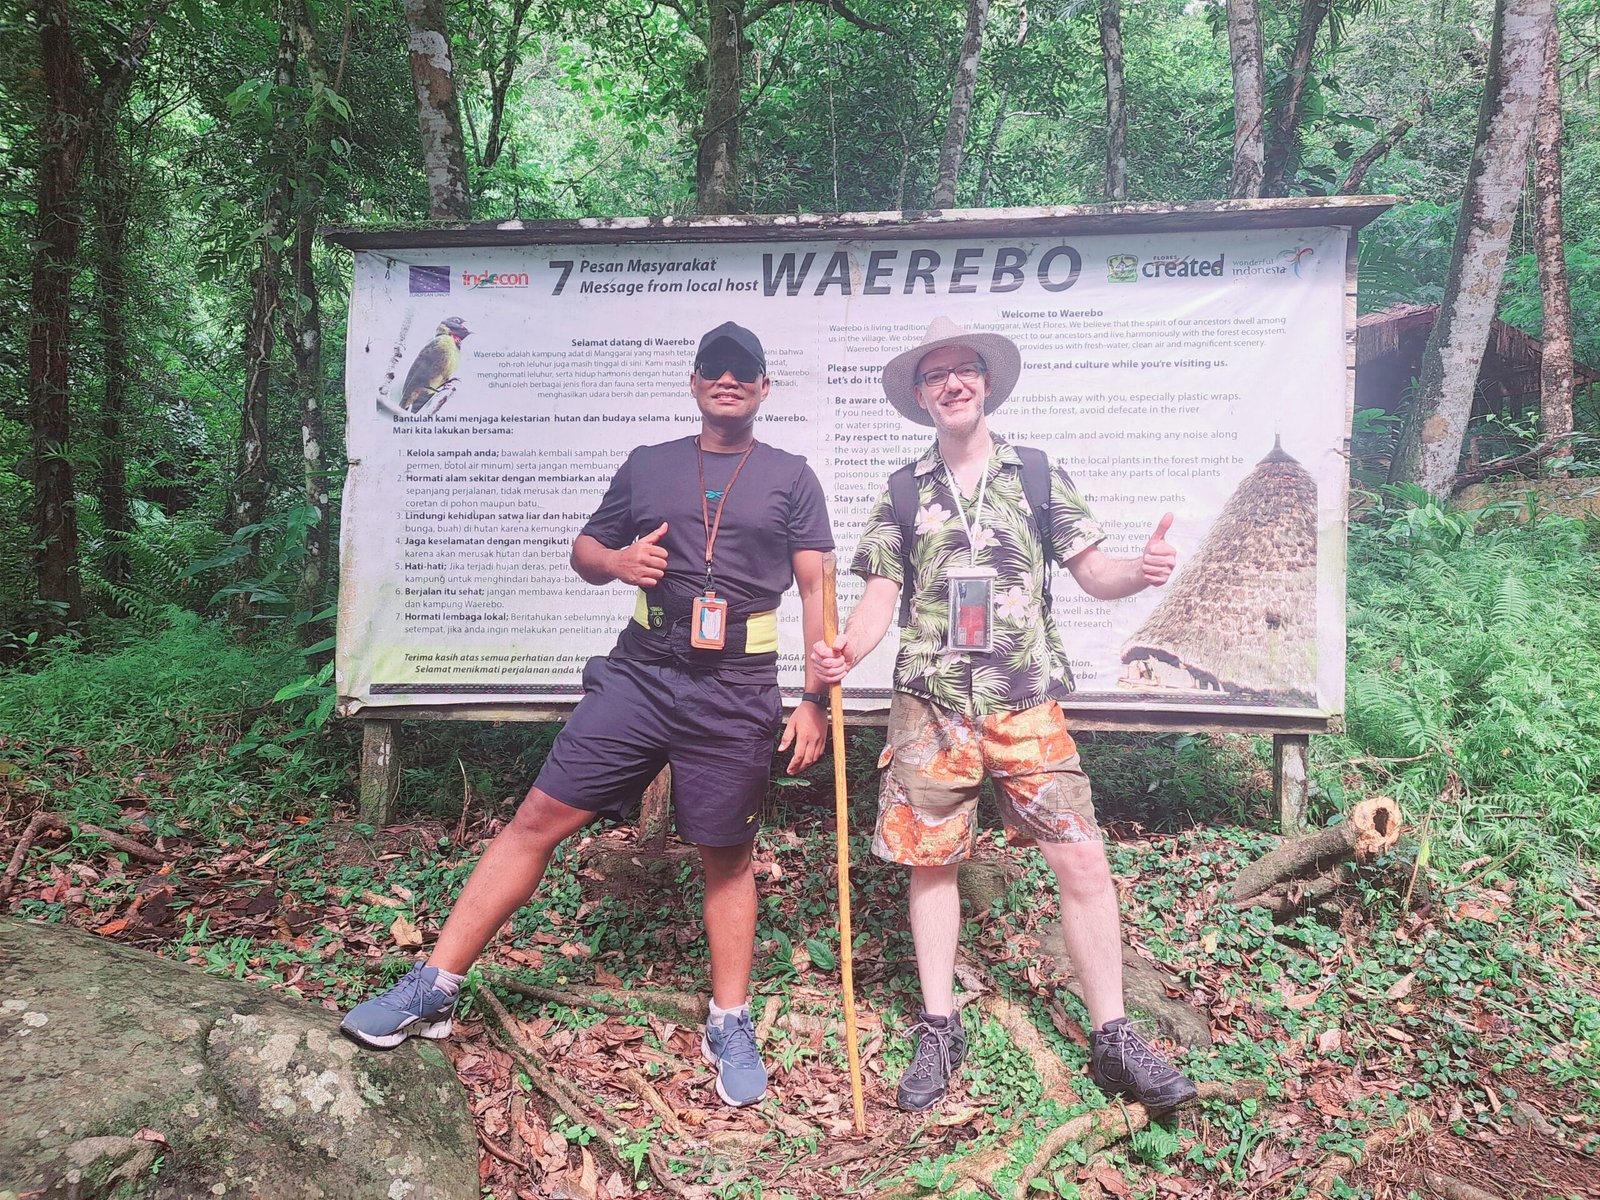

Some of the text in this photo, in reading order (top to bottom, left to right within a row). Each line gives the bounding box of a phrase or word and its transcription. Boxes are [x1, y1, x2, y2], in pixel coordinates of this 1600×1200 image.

[580, 257, 716, 276] Pesan Masyarakat
[1142, 253, 1224, 278] created
[1232, 258, 1274, 266] wonderful
[762, 246, 1083, 296] WAEREBO
[1232, 266, 1287, 276] indonesia
[462, 270, 528, 286] indecon
[549, 260, 574, 296] 7
[580, 278, 759, 295] Message from local host
[1002, 310, 1046, 318] Welcome
[1059, 309, 1103, 317] Waerebo
[1125, 329, 1180, 338] harmoniously
[572, 338, 695, 348] Selamat datang di Waerebo
[532, 349, 567, 359] kampung
[594, 349, 633, 358] Manggarai
[676, 349, 695, 358] tetap
[828, 363, 858, 371] Please
[1024, 360, 1052, 369] forest
[1053, 360, 1073, 369] and
[1074, 360, 1110, 368] culture
[1111, 359, 1139, 368] while
[1141, 359, 1172, 370] you're
[1174, 358, 1212, 369] visiting
[828, 375, 872, 384] Let's do it
[835, 395, 847, 404] Be
[1022, 392, 1241, 404] rubbish away with you, especially plastic wraps.
[393, 413, 670, 424] Bantulah kami menjaga kelestarian hutan dan budaya selama
[765, 412, 808, 421] Waerebo.
[393, 425, 514, 434] Mari kita lakukan bersama:
[872, 420, 902, 431] spring.
[834, 432, 851, 443] Pay
[853, 433, 888, 443] respect
[1008, 430, 1237, 442] it is; keep calm and avoid making any noise along
[407, 448, 608, 459] Kelola sampah anda; bawalah kembali sampah
[834, 456, 886, 465] Protect the
[406, 473, 595, 484] Hormati alam sekitar dengan membiarkan
[834, 493, 875, 504] Stay safe
[1100, 493, 1135, 504] making
[1160, 493, 1185, 504] paths
[405, 511, 446, 522] Lindungi
[447, 511, 496, 522] kehidupan
[526, 511, 541, 519] liar
[542, 511, 560, 519] dan
[1123, 519, 1152, 530] you're
[405, 536, 569, 547] Jaga keselamatan dengan mengikuti
[395, 561, 570, 572] 5. Hati-hati; Jika terjadi hujan deras, petir,
[395, 586, 610, 597] 6. Berjalan itu sehat; jangan membawa kendaraan
[405, 599, 504, 610] dan kampung Waerebo.
[395, 611, 616, 623] 7. Hormati lembaga lokal; Beritahukan sebelumnya
[1074, 619, 1112, 627] research
[405, 652, 434, 661] Terima
[435, 652, 458, 661] kasih
[511, 652, 555, 664] perhatian
[556, 652, 574, 661] dan
[415, 664, 574, 675] Selamat menikmati perjalanan anda
